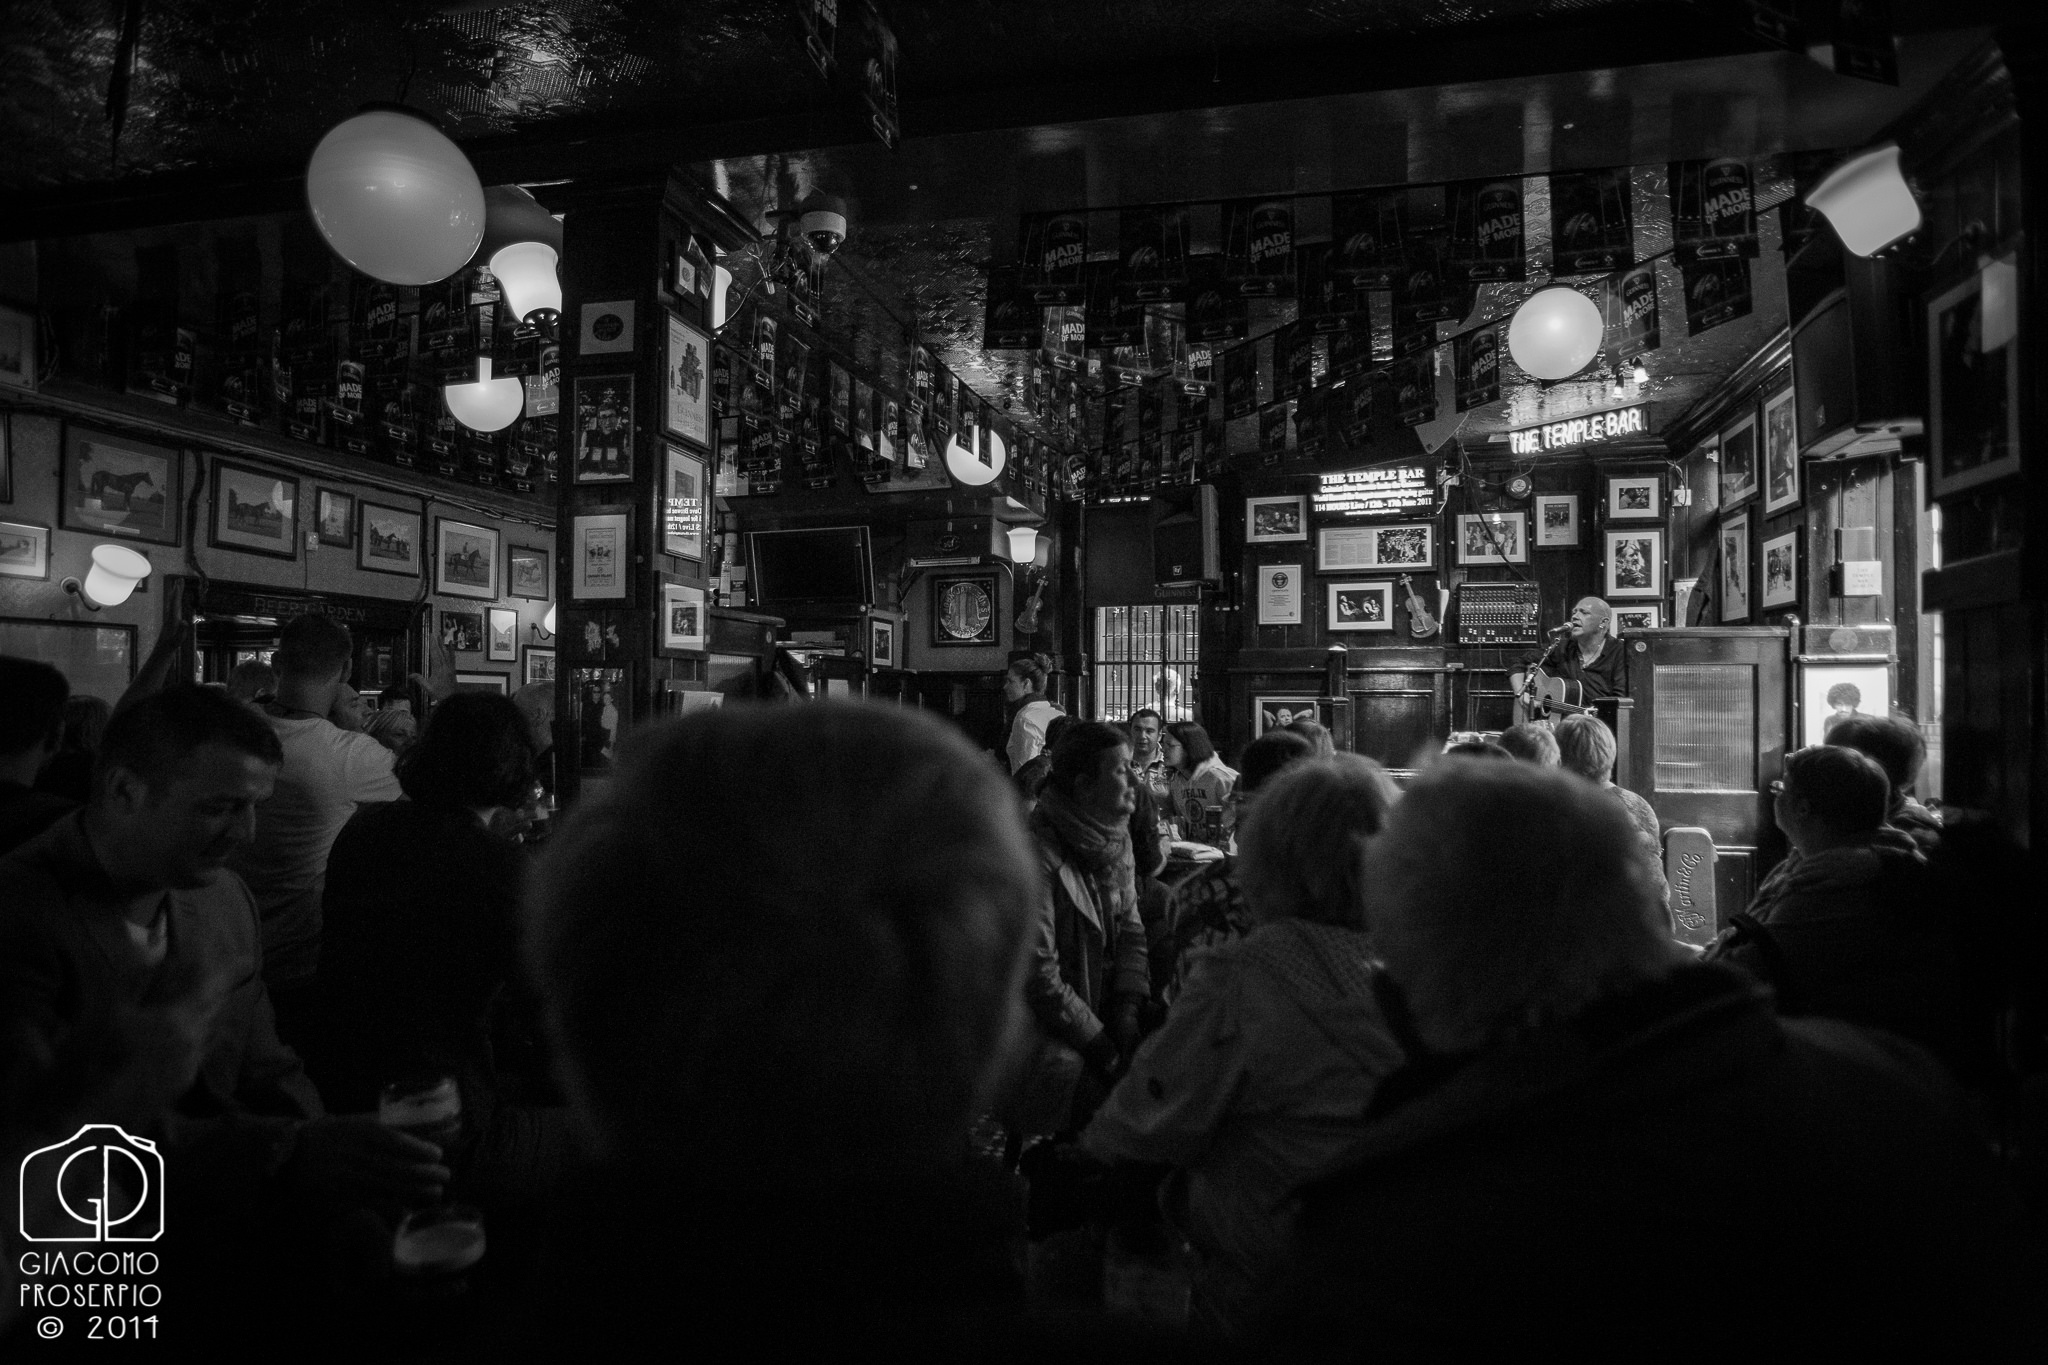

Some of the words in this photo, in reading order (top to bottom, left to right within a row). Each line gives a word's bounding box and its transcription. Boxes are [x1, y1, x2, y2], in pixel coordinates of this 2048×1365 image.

[1704, 187, 1751, 215] MADE
[1477, 213, 1521, 238] MADE
[1045, 242, 1083, 264] MADE
[1250, 231, 1291, 255] MADE
[367, 301, 397, 322] MADE
[1623, 290, 1654, 322] MADE
[1070, 333, 1085, 341] MOR
[543, 367, 560, 384] MAD
[339, 383, 362, 393] MADE
[1509, 429, 1541, 454] THE
[1542, 415, 1604, 449] TEMPLE
[1605, 407, 1642, 436] BAR
[1321, 474, 1346, 484] THE
[1347, 470, 1397, 483] TEMPLE
[1398, 468, 1425, 480] BAR
[1418, 488, 1434, 497] guitar
[1315, 504, 1326, 512] 114
[1326, 502, 1350, 511] HOURS
[1350, 501, 1364, 509] Live
[1402, 498, 1416, 506] June
[1417, 497, 1432, 505] 2011
